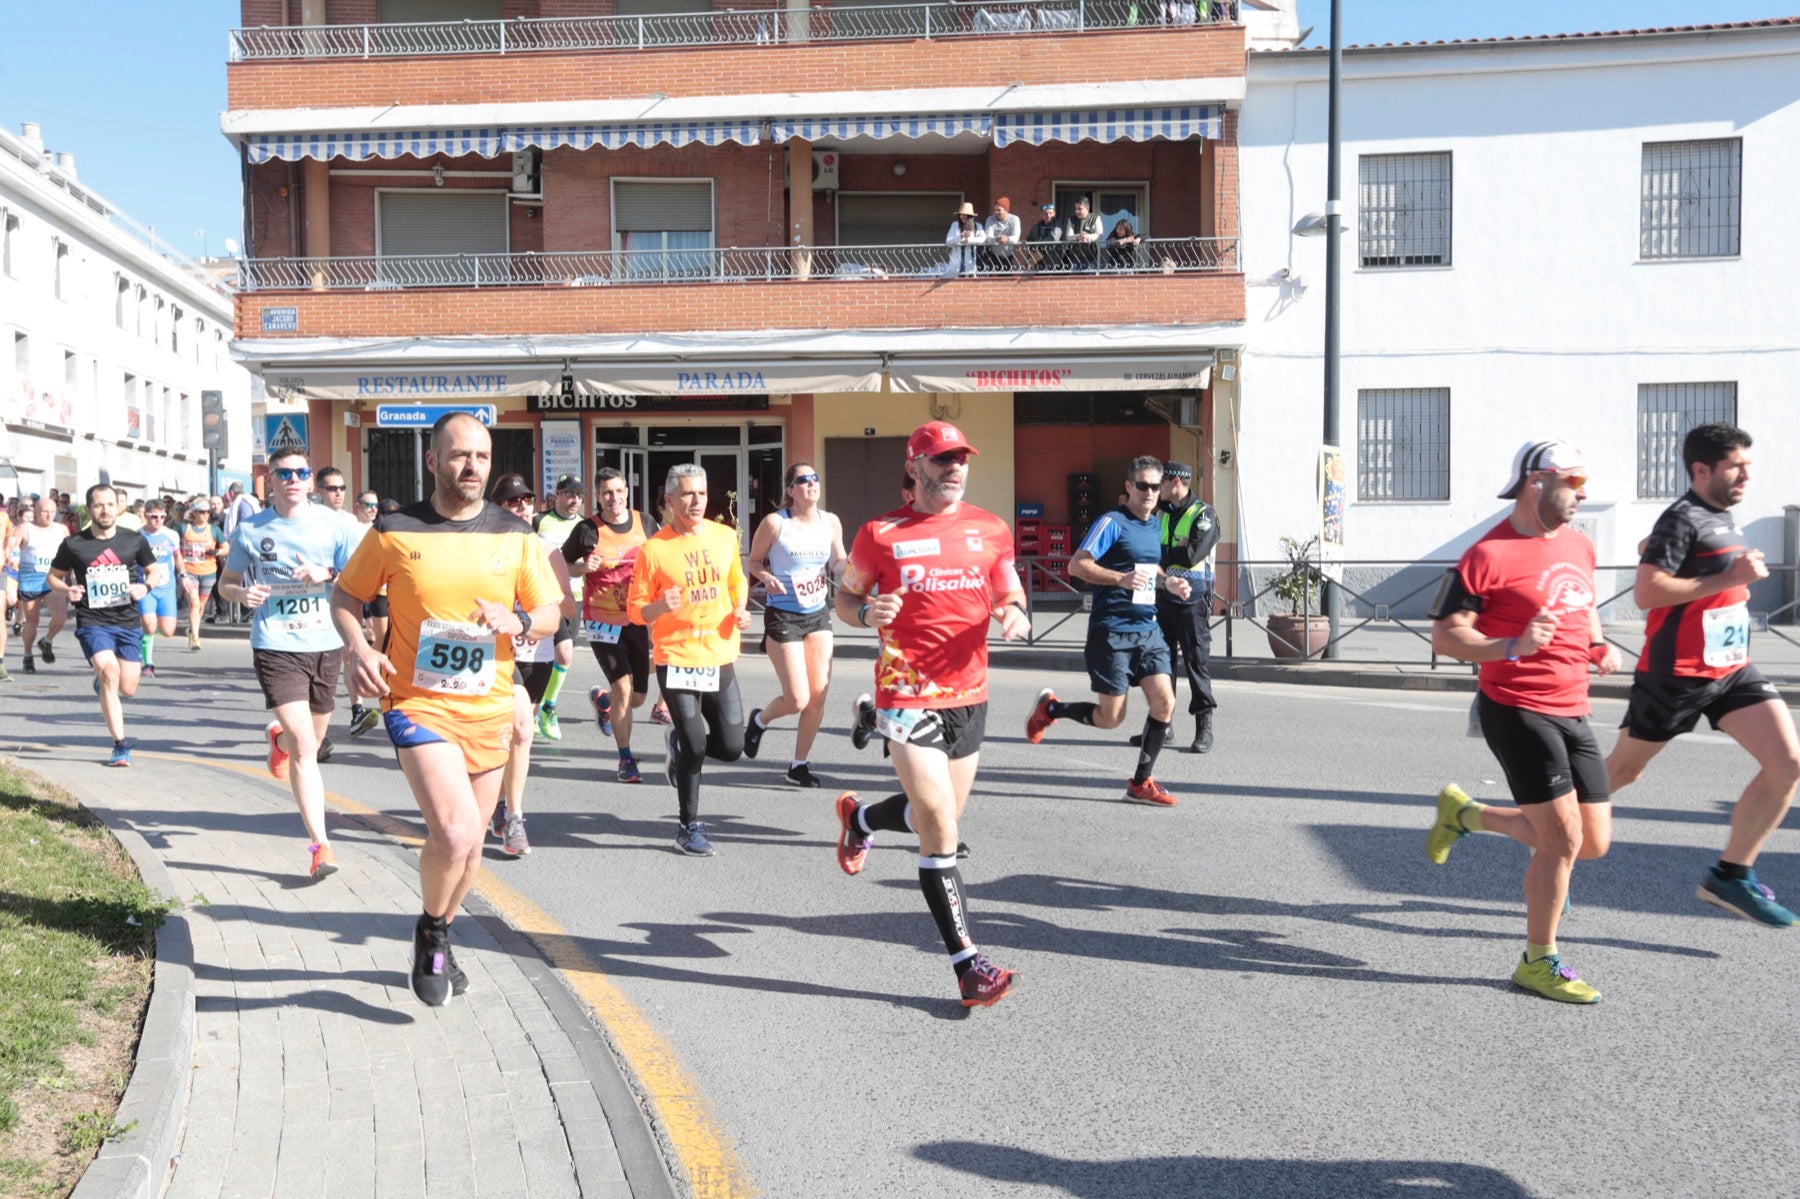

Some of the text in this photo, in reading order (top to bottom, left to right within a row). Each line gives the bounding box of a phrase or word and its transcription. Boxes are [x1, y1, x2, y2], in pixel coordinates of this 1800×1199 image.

[264, 322, 296, 330] CAMARERO
[357, 374, 508, 395] RESTAURANTE
[677, 372, 767, 390] PARADA
[1135, 372, 1166, 380] CERVEZAS
[537, 393, 638, 409] BICHITOS
[380, 411, 426, 421] Granada
[684, 549, 712, 568] WE
[685, 567, 721, 588] RUN
[901, 563, 985, 593] Polisalud
[91, 582, 127, 597] 1090
[690, 586, 718, 604] MAD
[276, 596, 320, 615] 1201
[430, 643, 485, 674] 598
